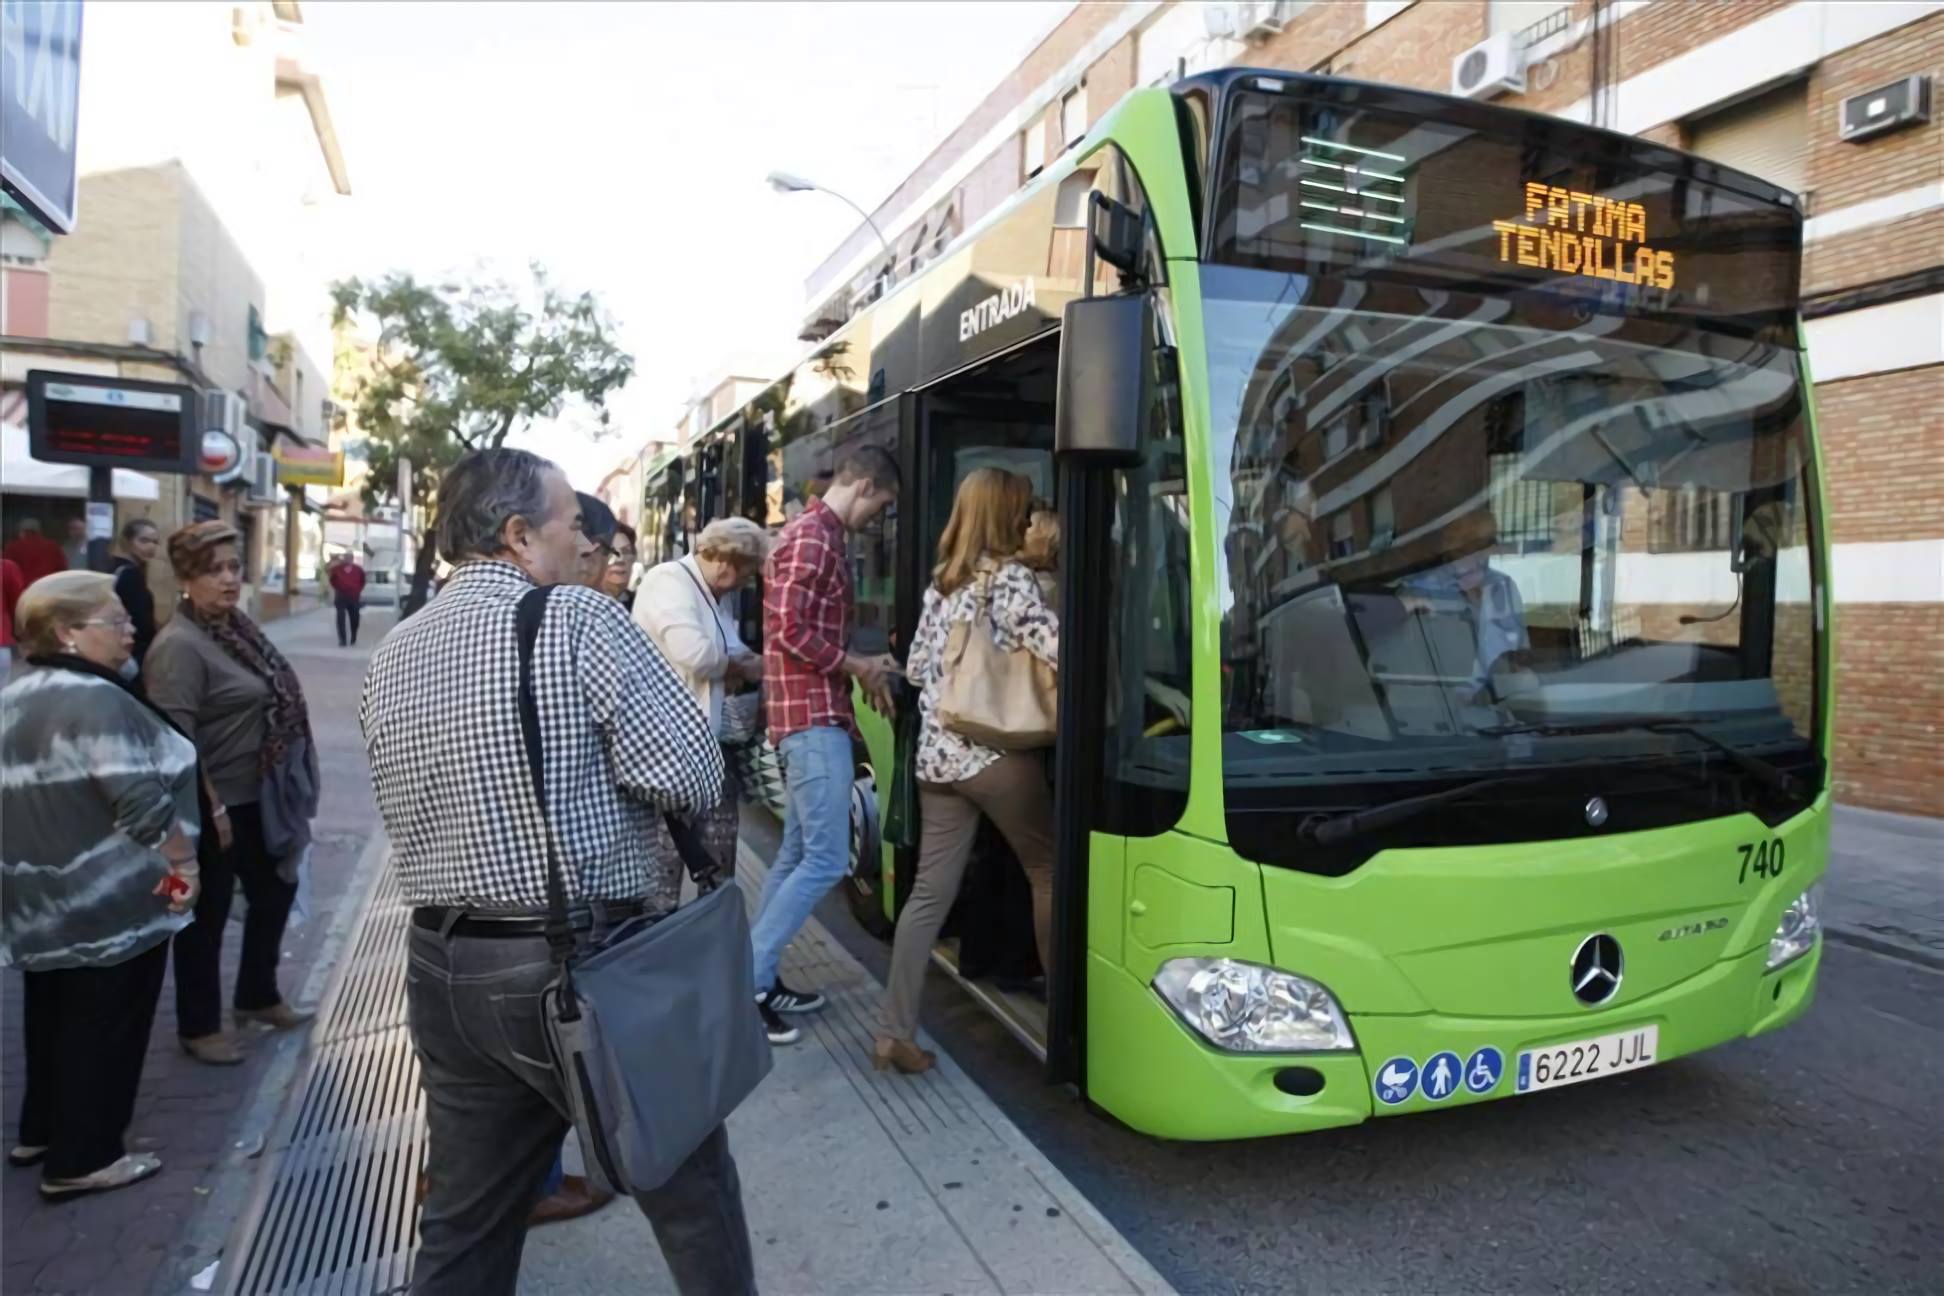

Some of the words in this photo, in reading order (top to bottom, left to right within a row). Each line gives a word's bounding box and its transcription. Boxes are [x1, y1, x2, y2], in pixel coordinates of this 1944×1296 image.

[1526, 182, 1646, 243] FATIMA
[1493, 220, 1675, 290] TENDILLAS
[960, 275, 1036, 342] ENTRADA
[1737, 838, 1785, 884] 740
[1536, 1043, 1600, 1084] 6222
[1609, 1032, 1652, 1069] JJL
